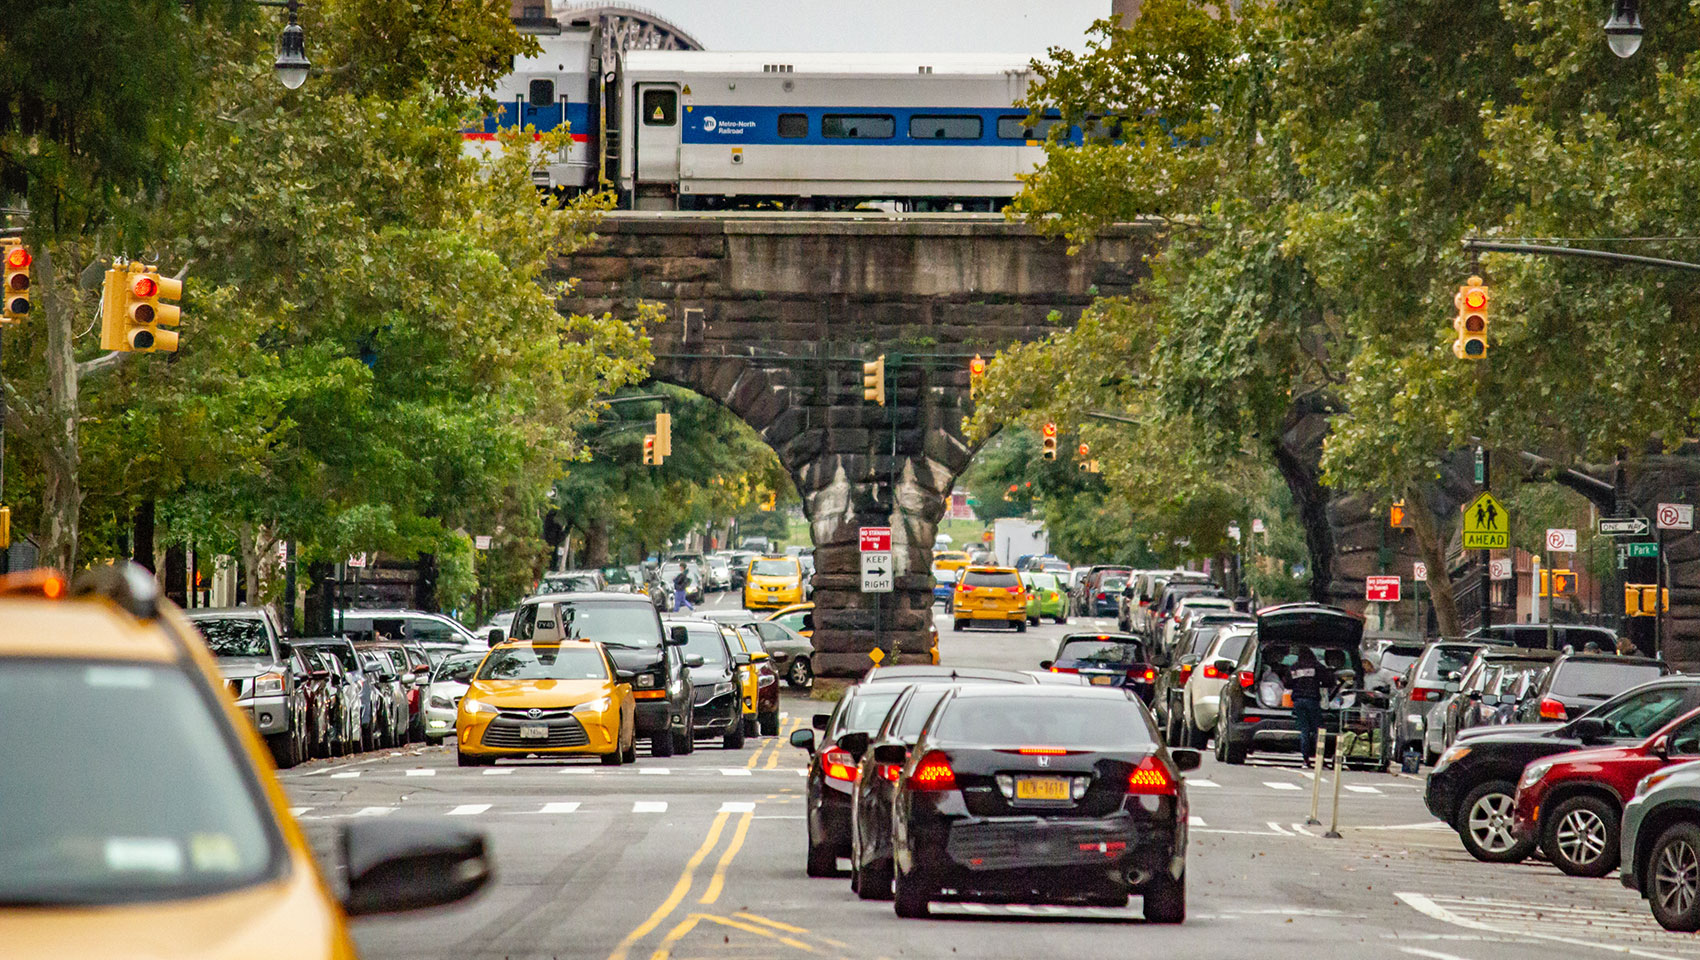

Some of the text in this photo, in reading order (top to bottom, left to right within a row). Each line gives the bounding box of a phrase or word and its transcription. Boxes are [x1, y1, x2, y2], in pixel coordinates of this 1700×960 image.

[718, 120, 756, 128] Metro-North
[718, 127, 744, 135] Railroad
[1603, 523, 1643, 531] ONE WAY
[1468, 534, 1505, 546] AHEAD
[1634, 545, 1650, 555] Park
[866, 555, 888, 564] KEEP
[864, 580, 890, 589] RIGHT
